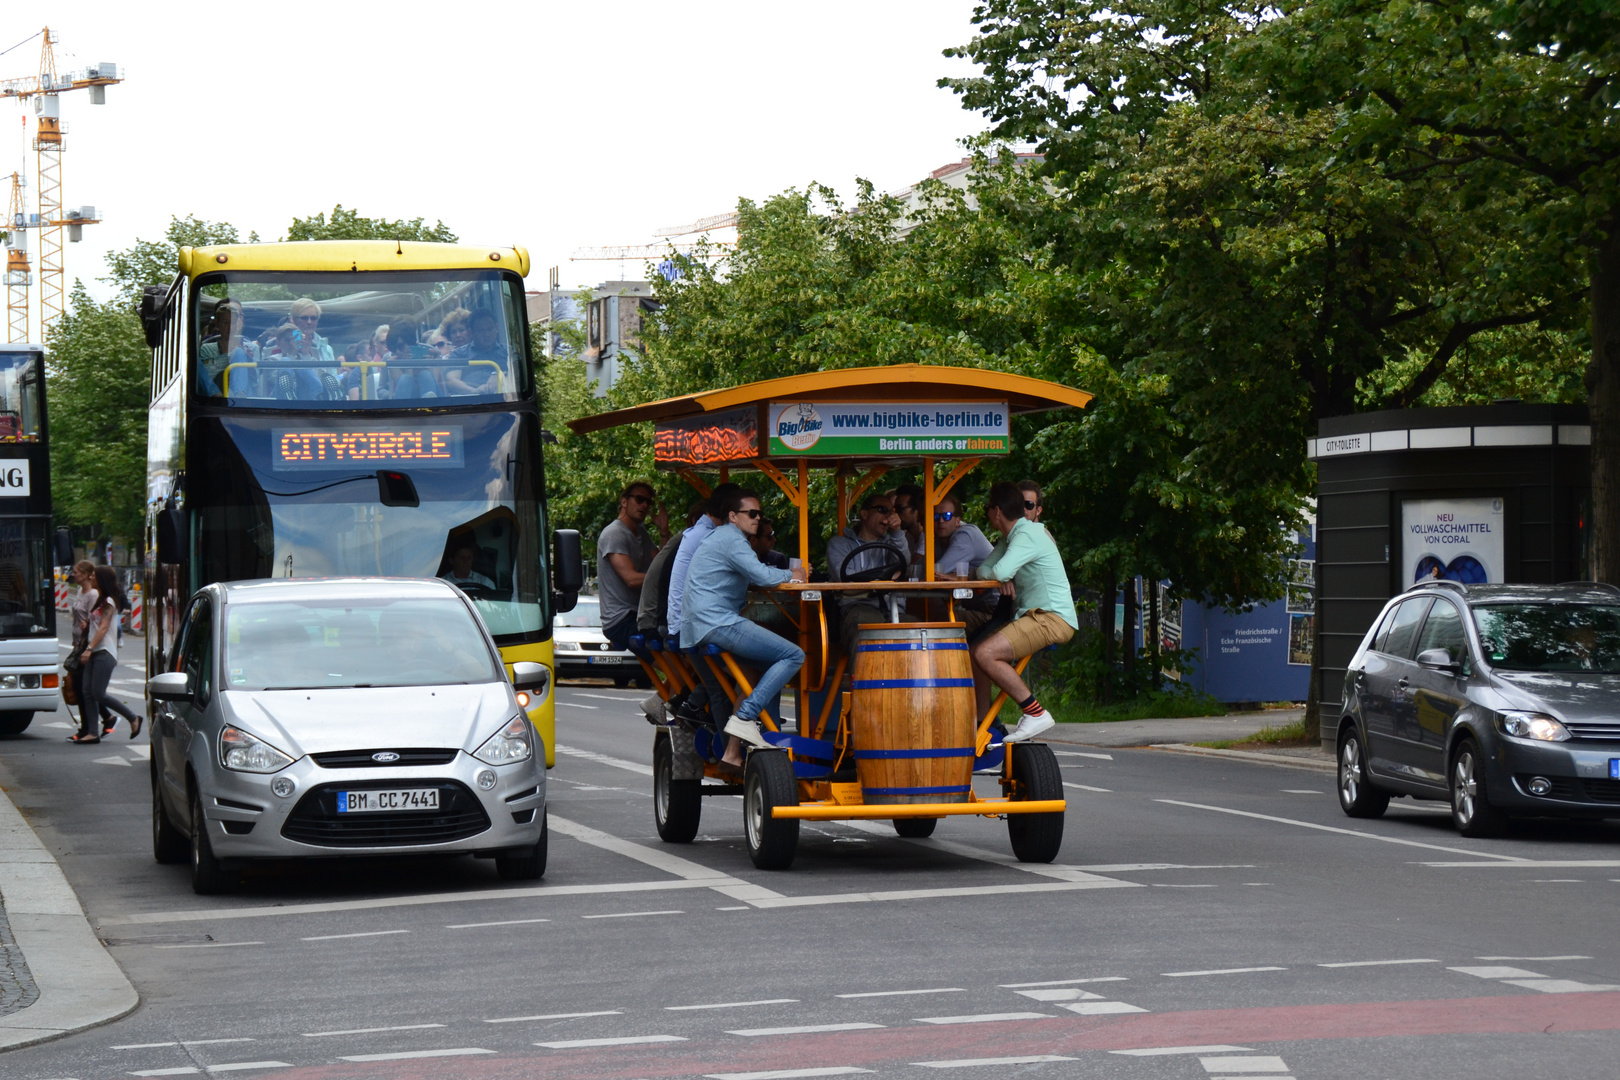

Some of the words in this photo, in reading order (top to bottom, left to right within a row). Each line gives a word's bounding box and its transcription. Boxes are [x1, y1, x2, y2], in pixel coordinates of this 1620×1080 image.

[832, 411, 1003, 429] www.bigbike-berlin.de
[779, 422, 798, 436] Big
[804, 419, 823, 432] Bike
[281, 432, 450, 460] CITYCIRCLE
[879, 439, 913, 450] Berlin
[914, 438, 953, 450] anders
[955, 438, 1006, 450] erfahren.
[1326, 437, 1361, 452] CITY-TOILETTE
[1436, 513, 1454, 522] NEU
[1410, 523, 1491, 534] VOLLWASCHMITTEL
[1424, 536, 1440, 544] VON
[1441, 535, 1470, 544] CORAL
[1235, 627, 1278, 636] Friedrichstraße
[1235, 637, 1272, 645] Französische
[377, 753, 396, 761] Ford
[348, 793, 368, 809] BM
[379, 792, 398, 808] CC
[401, 790, 438, 808] 7441
